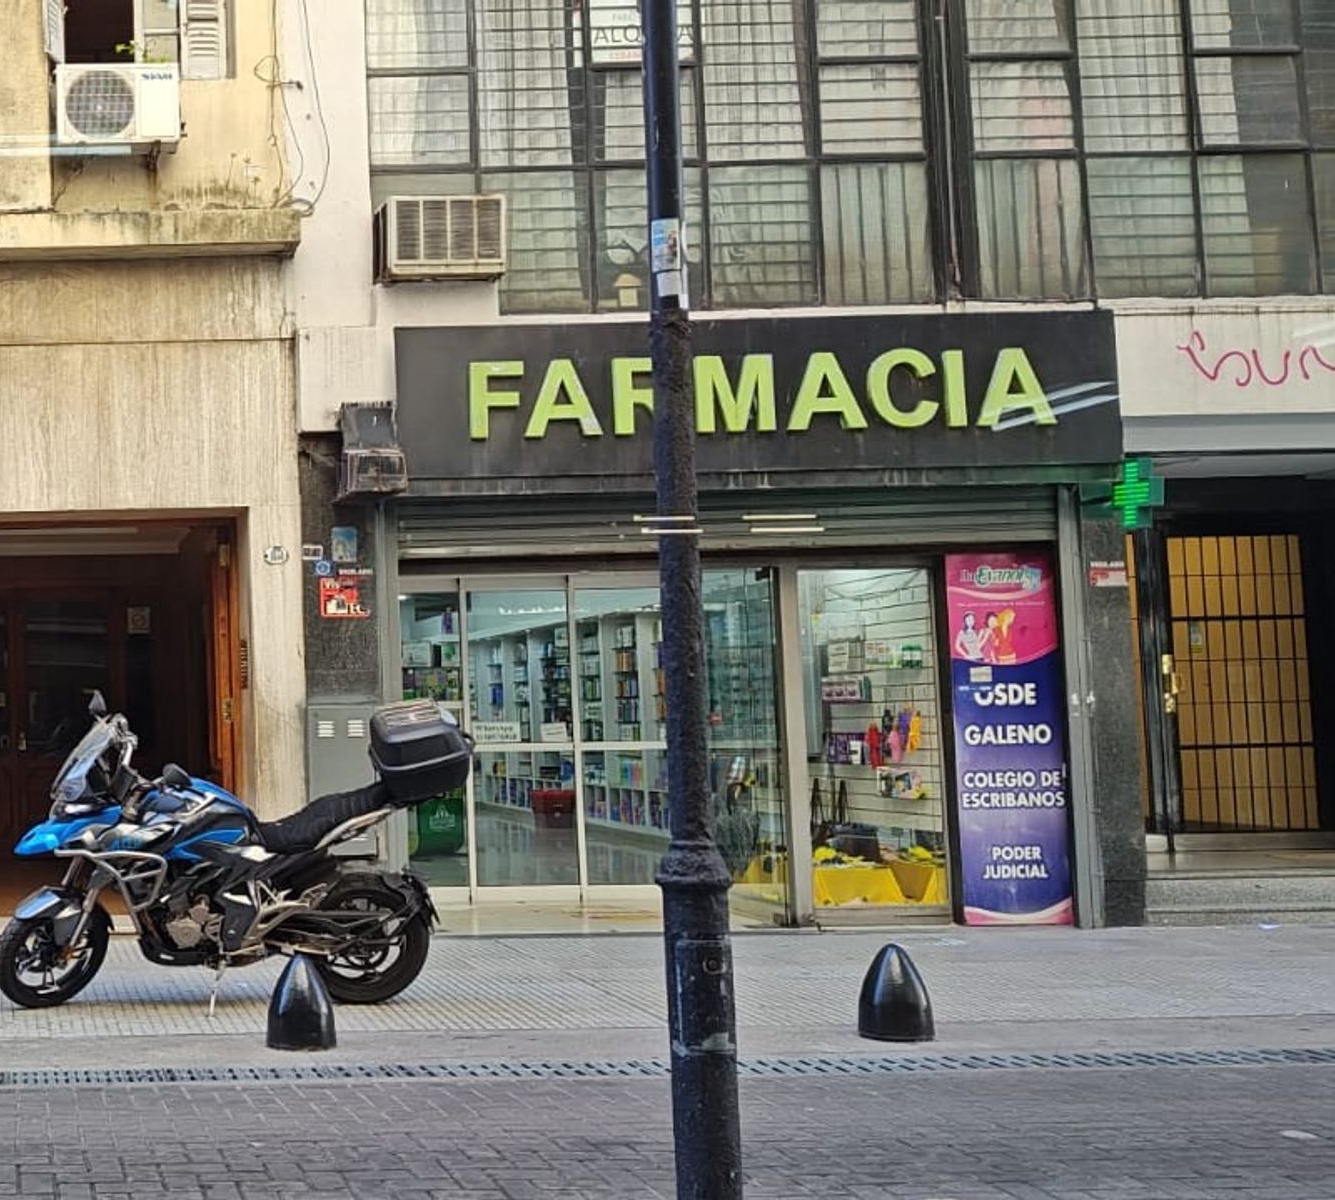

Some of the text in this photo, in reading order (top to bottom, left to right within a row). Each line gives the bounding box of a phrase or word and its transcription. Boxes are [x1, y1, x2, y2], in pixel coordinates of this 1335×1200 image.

[593, 25, 694, 44] ALQA
[974, 682, 1037, 706] OSDE
[964, 724, 1052, 745] GALENO
[964, 770, 1061, 788] COLEGIO DE
[962, 791, 1065, 808] ESCRIBANOS
[991, 846, 1042, 860] PODER
[983, 864, 1049, 879] JUDICIAL
